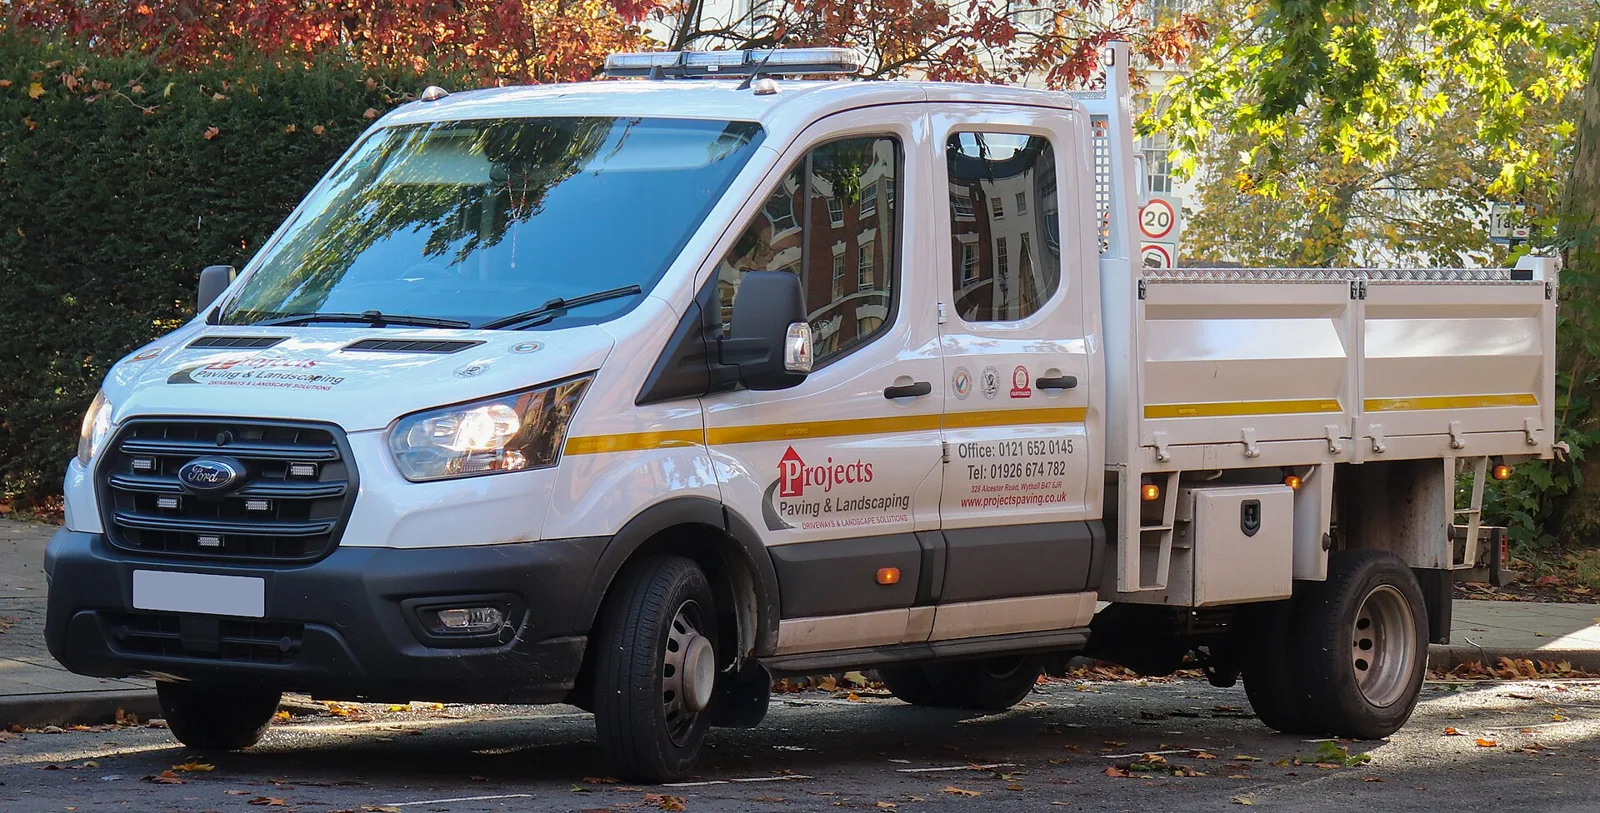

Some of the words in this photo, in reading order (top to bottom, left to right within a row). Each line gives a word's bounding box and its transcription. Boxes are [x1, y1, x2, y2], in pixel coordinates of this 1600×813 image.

[1145, 211, 1169, 228] 20
[195, 370, 240, 379] Paving
[242, 370, 254, 379] &
[255, 371, 345, 385] Landscaping
[292, 383, 332, 391] SOLUTIONS
[958, 443, 995, 459] Office:
[999, 441, 1023, 457] 0121
[1027, 440, 1046, 456] 652
[1049, 439, 1074, 455] 0145
[188, 464, 219, 482] Ford
[781, 456, 874, 494] Projects
[967, 465, 987, 480] Tel:
[990, 463, 1022, 479] 01926
[1025, 461, 1044, 477] 674
[1047, 461, 1066, 476] 782
[981, 483, 1004, 493] Alcester
[1004, 483, 1020, 492] Road,
[1020, 482, 1040, 492] Wythall
[1040, 481, 1052, 490] B47
[779, 500, 820, 518] Paving
[823, 498, 832, 513] &
[836, 493, 910, 512] Landscaping
[961, 491, 1067, 509] www.projectspaving.co.uk
[802, 519, 835, 530] DRIVEWAYS
[836, 519, 841, 527] &
[842, 517, 876, 527] LANDSCAPE
[876, 514, 908, 524] SOLUTIONS
